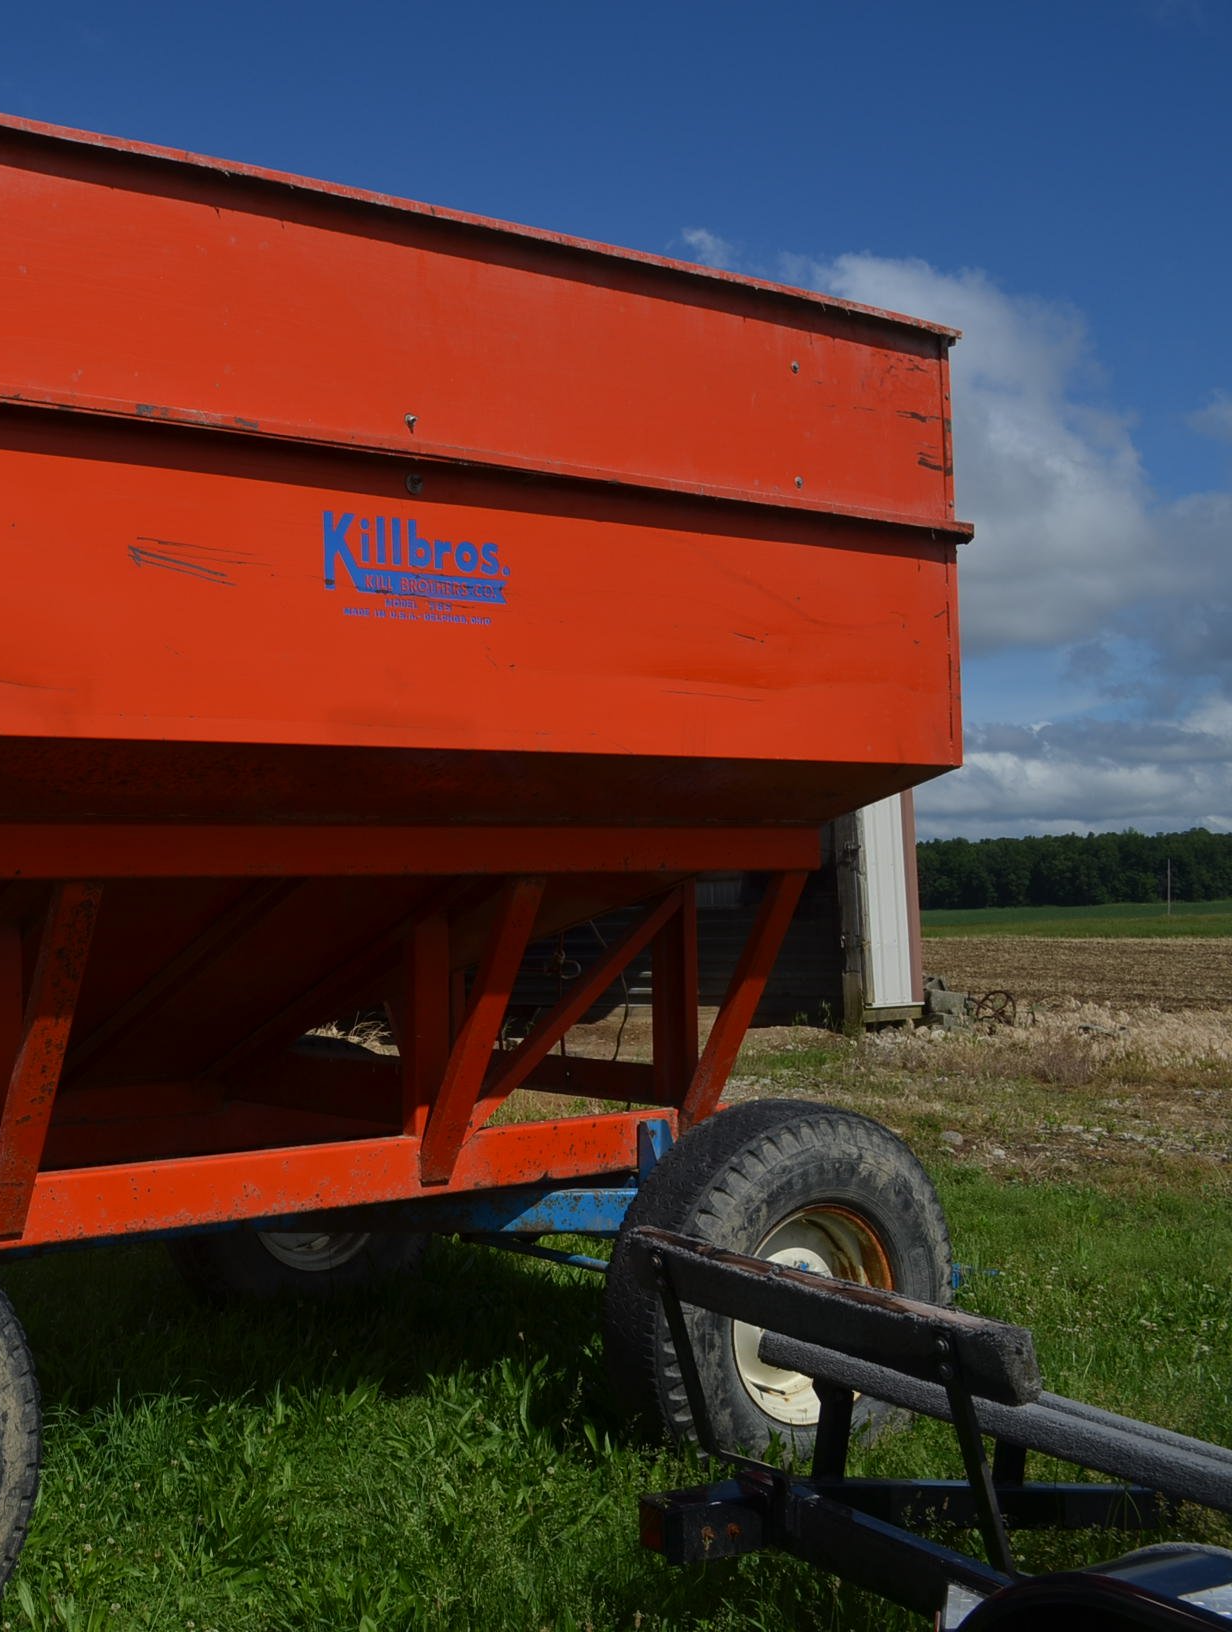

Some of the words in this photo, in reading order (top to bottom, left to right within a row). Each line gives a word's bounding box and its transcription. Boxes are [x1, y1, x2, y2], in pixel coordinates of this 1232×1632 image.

[323, 511, 511, 590] Killbros.
[365, 575, 393, 591] KILL
[400, 577, 468, 596] BROTHERS
[472, 584, 497, 599] CO.
[385, 599, 417, 609] MODEL
[343, 608, 370, 617] MADE
[374, 608, 386, 618] IN
[471, 616, 492, 625] OHIO
